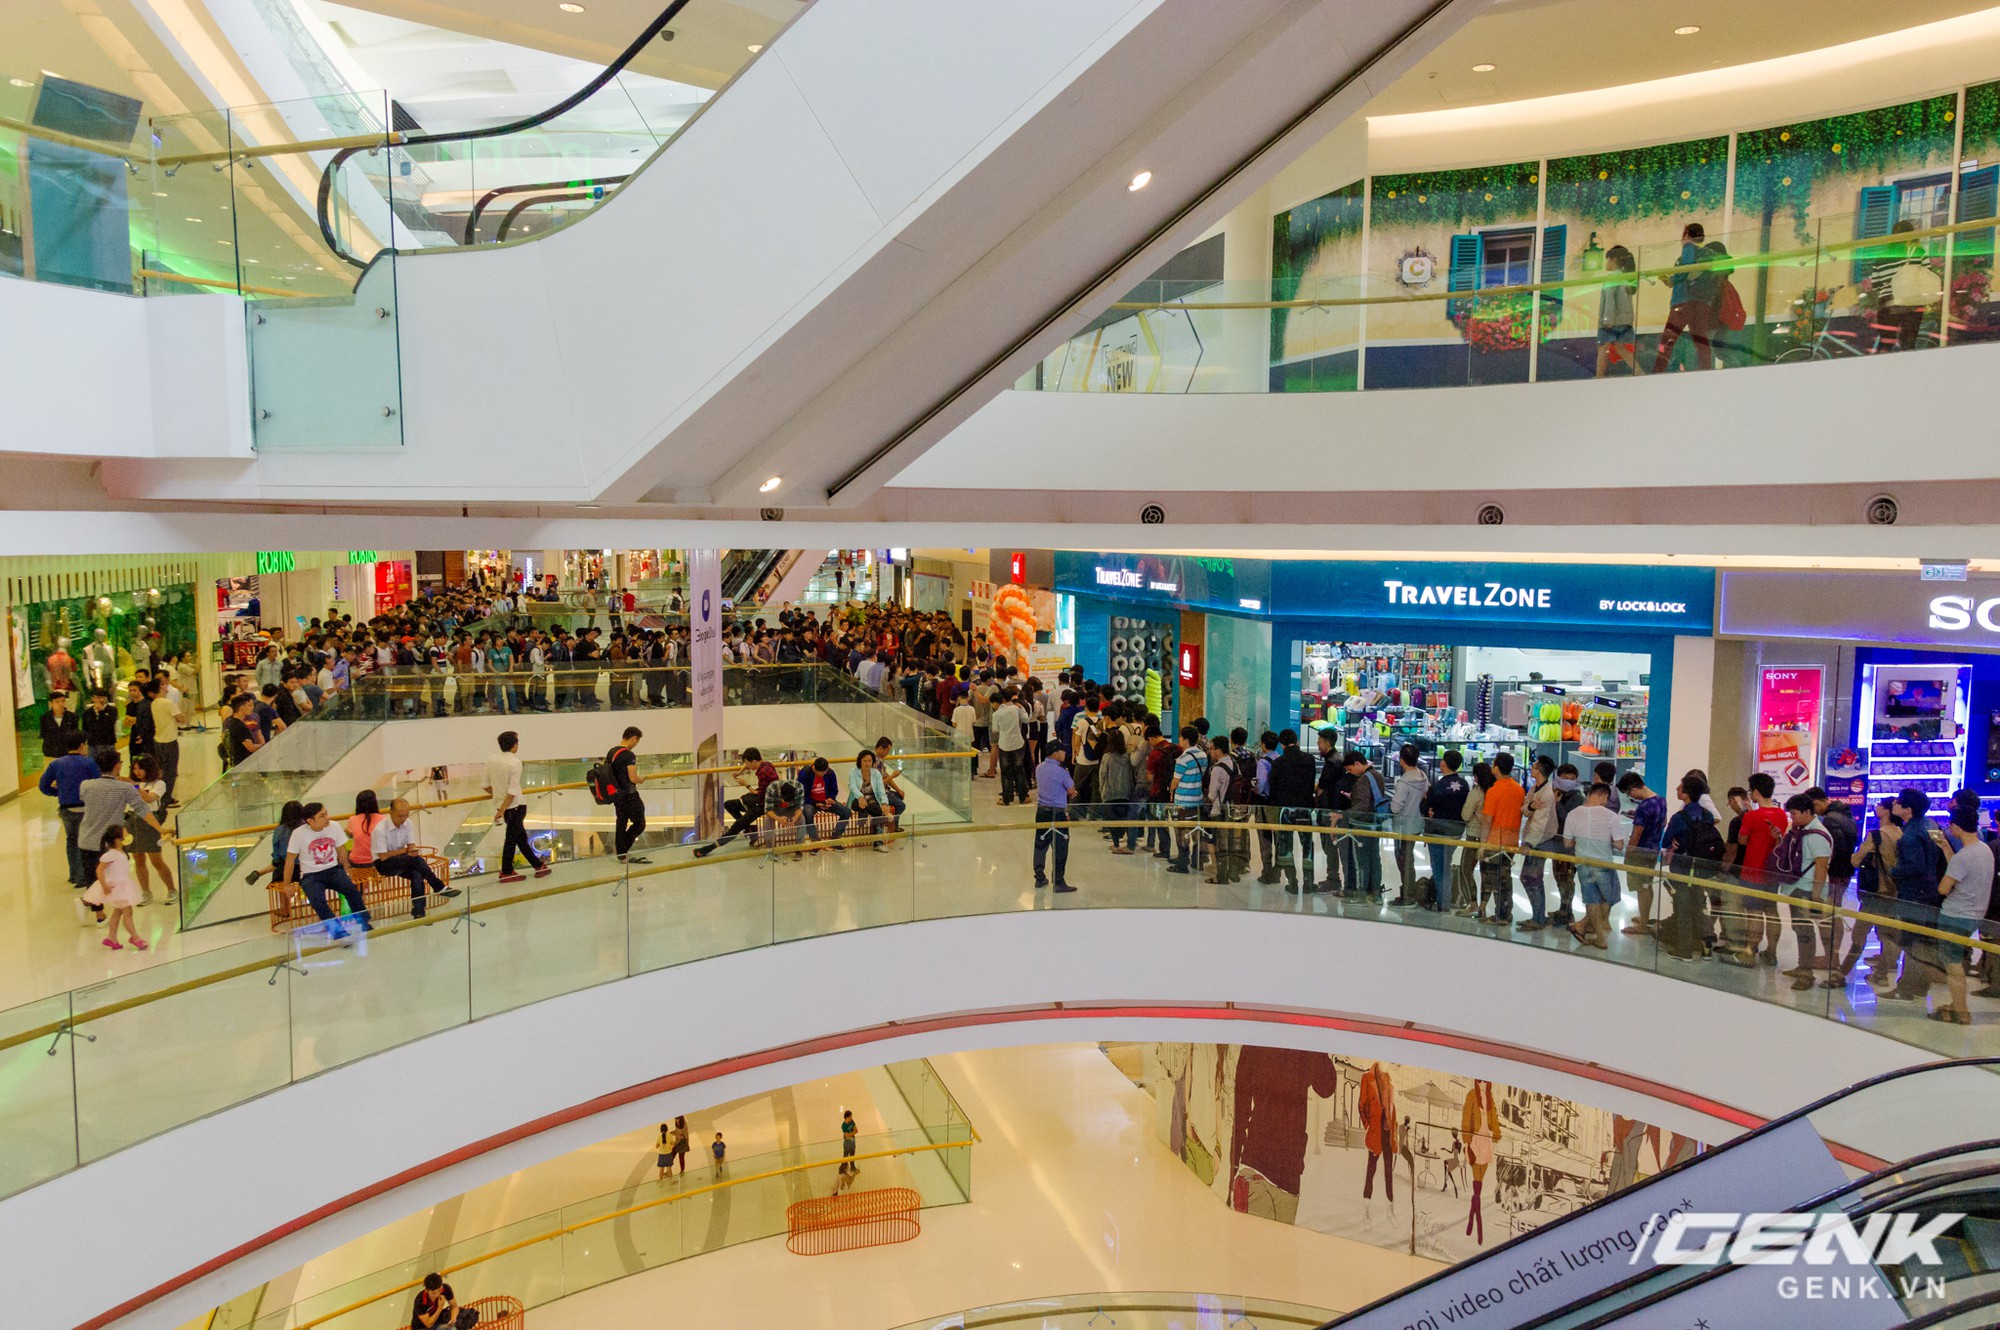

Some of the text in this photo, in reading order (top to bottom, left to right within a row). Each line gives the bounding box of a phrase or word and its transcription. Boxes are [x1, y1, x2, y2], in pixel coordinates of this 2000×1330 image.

[1104, 341, 1137, 365] SOMETHING
[1106, 359, 1134, 391] NEW
[257, 550, 296, 575] ROBINS
[1599, 599, 1687, 613] BY LOCK&LOCK
[1765, 672, 1798, 680] SONY
[1440, 1287, 1504, 1323] video
[1508, 1257, 1563, 1295] chất
[1561, 1229, 1637, 1271] lượng
